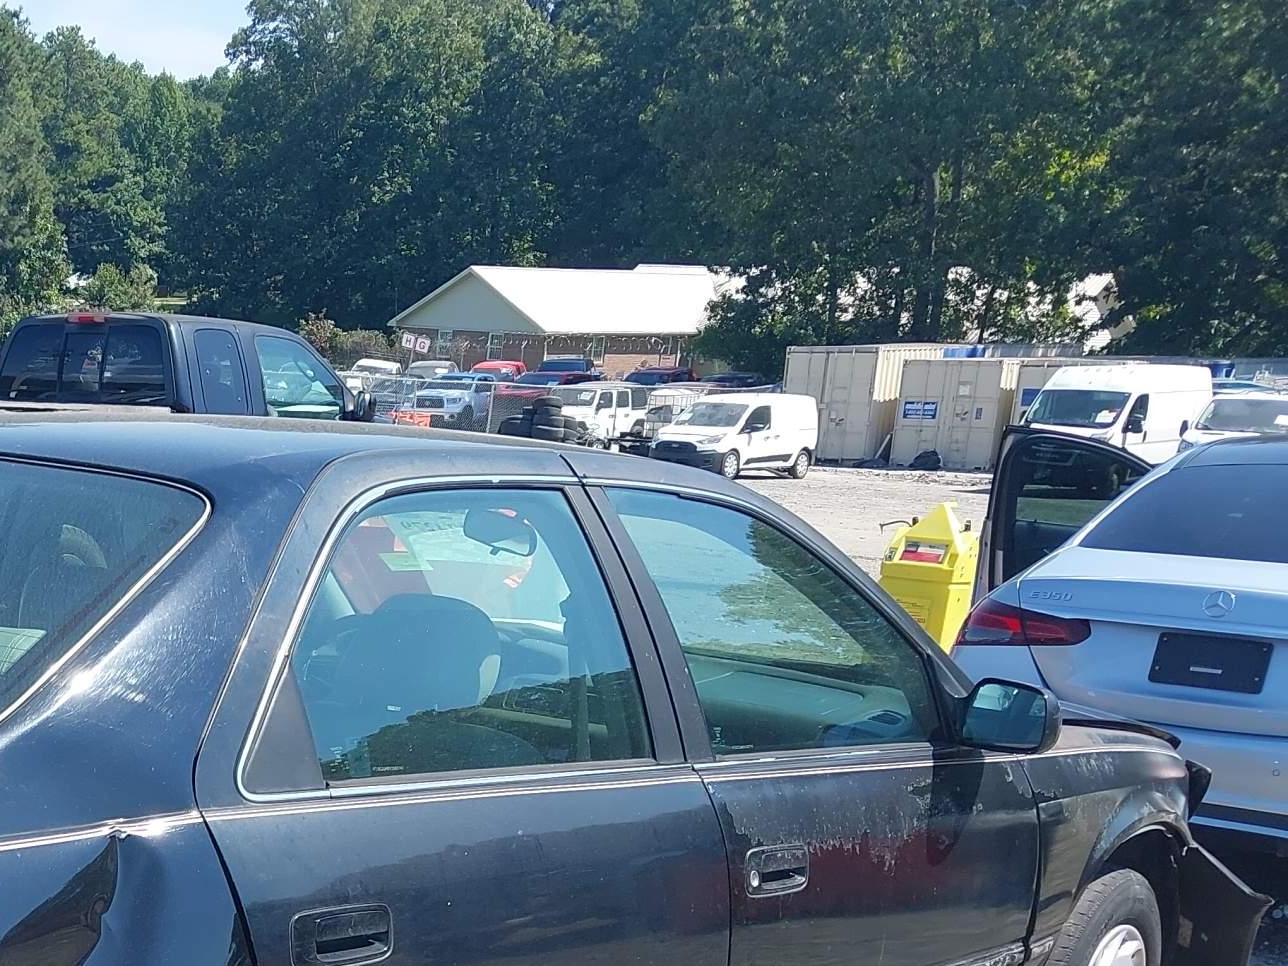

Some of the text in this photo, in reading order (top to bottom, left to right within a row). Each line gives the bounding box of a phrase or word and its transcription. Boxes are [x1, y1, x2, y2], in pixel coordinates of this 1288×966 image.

[405, 335, 412, 346] H
[418, 340, 427, 350] G
[1031, 591, 1073, 602] E350
